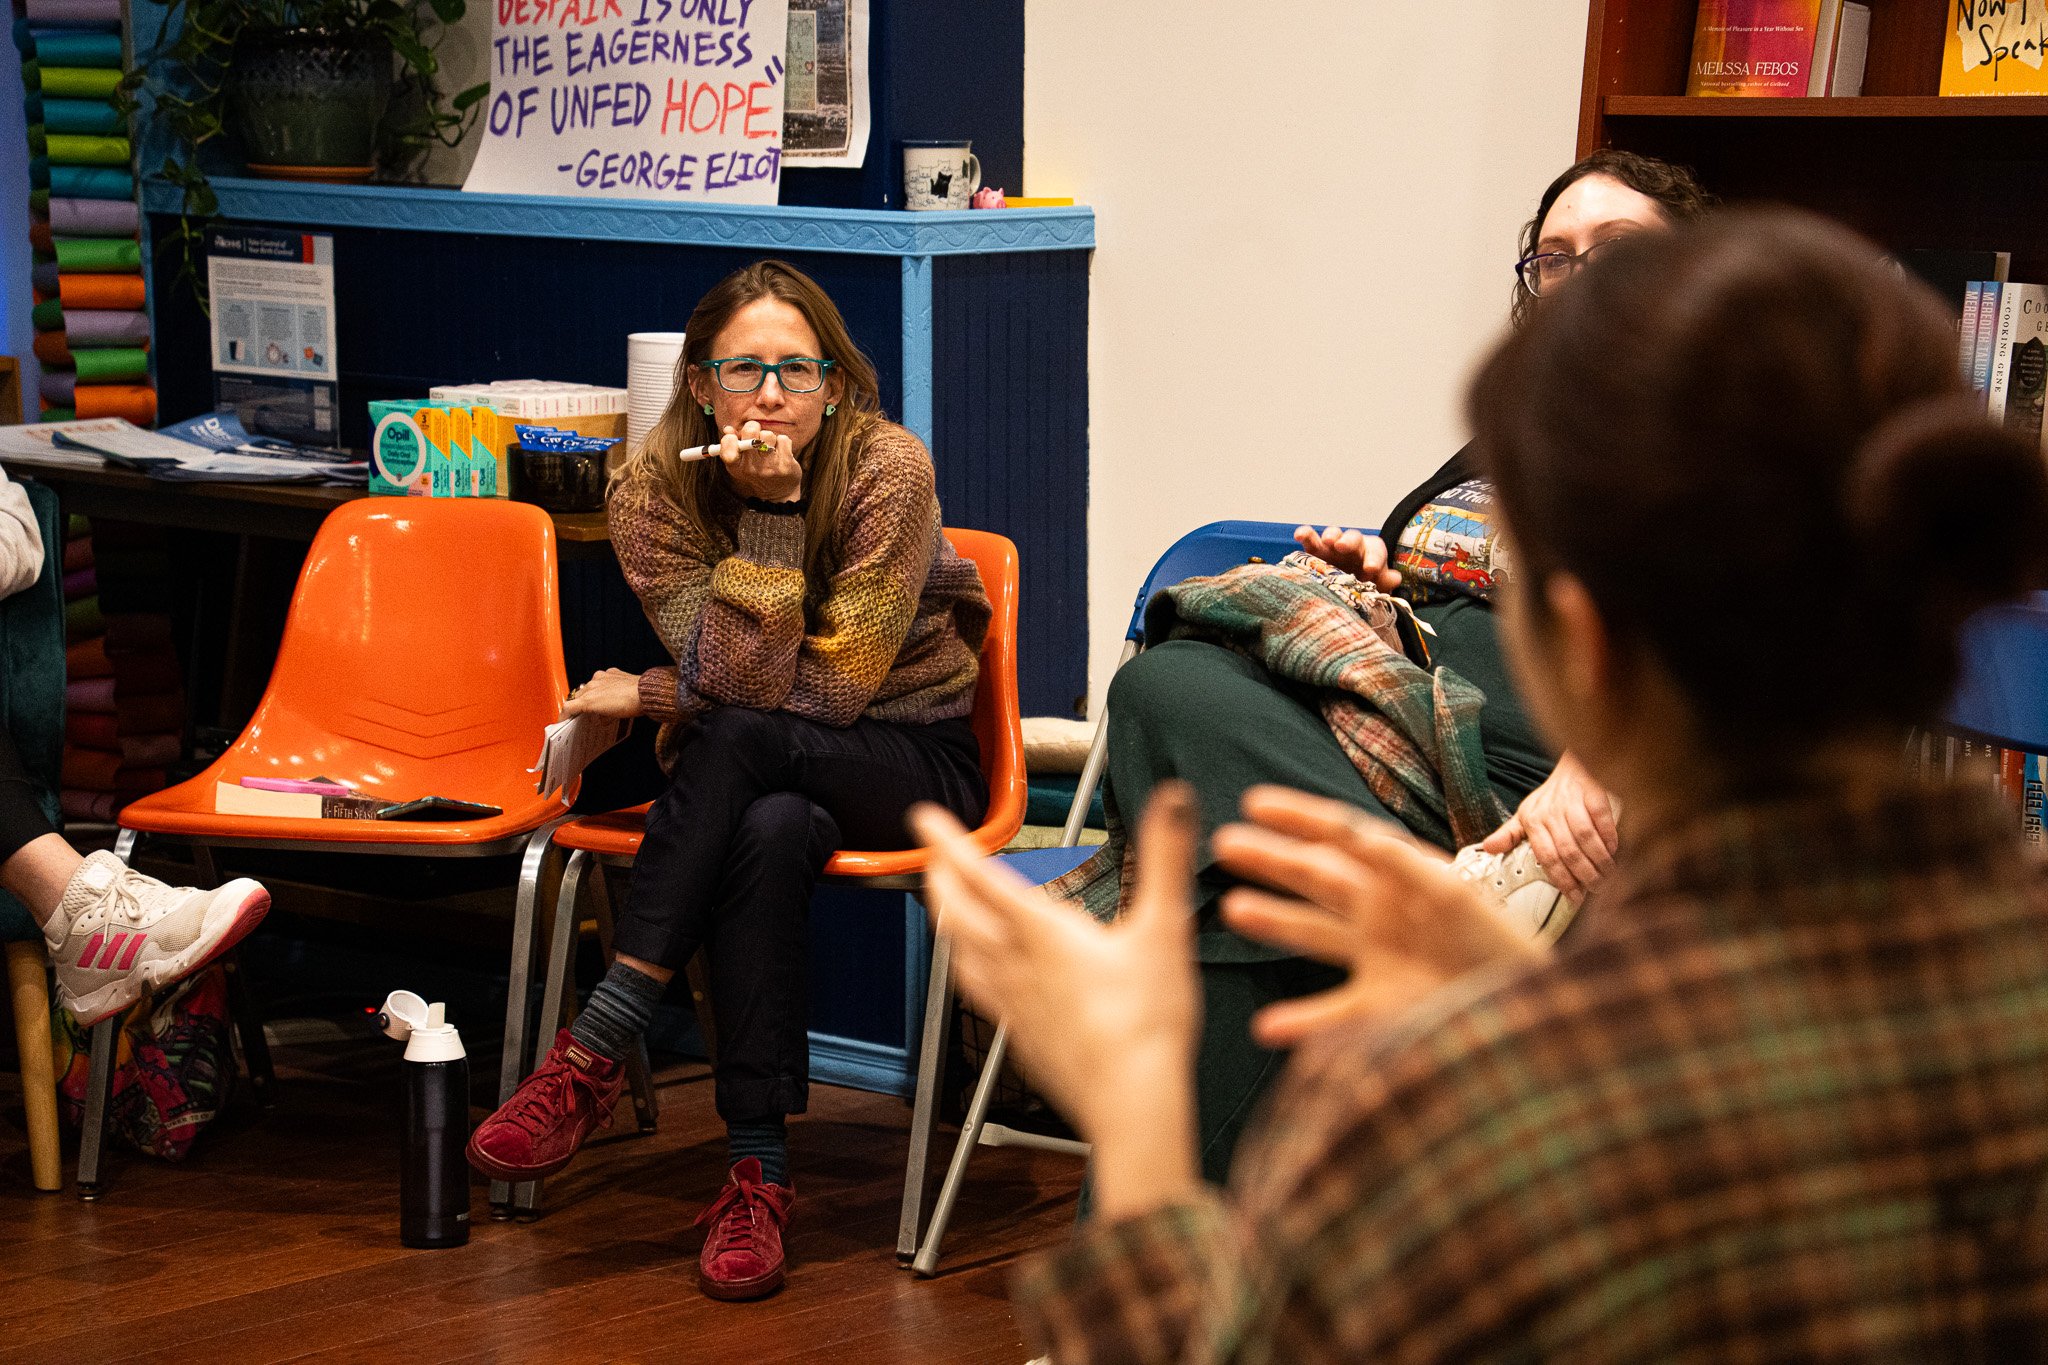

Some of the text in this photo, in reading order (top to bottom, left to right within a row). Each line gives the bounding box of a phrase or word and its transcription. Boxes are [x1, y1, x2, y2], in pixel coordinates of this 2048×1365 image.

[494, 34, 553, 76] THE
[566, 28, 753, 77] EAGERNESS
[1695, 61, 1799, 76] MELISSA FEBOS
[490, 86, 539, 138] OF
[551, 82, 652, 135] UNFED
[558, 147, 783, 192] -GEORGE ELIOT
[1978, 291, 1994, 342] MEREDITH
[1999, 306, 2012, 357] COOKING
[1994, 362, 2005, 393] GENE
[387, 427, 410, 442] Opill
[333, 805, 378, 820] FIFTH SEASO
[2028, 783, 2043, 814] FEEL
[567, 1051, 588, 1069] PUMA
